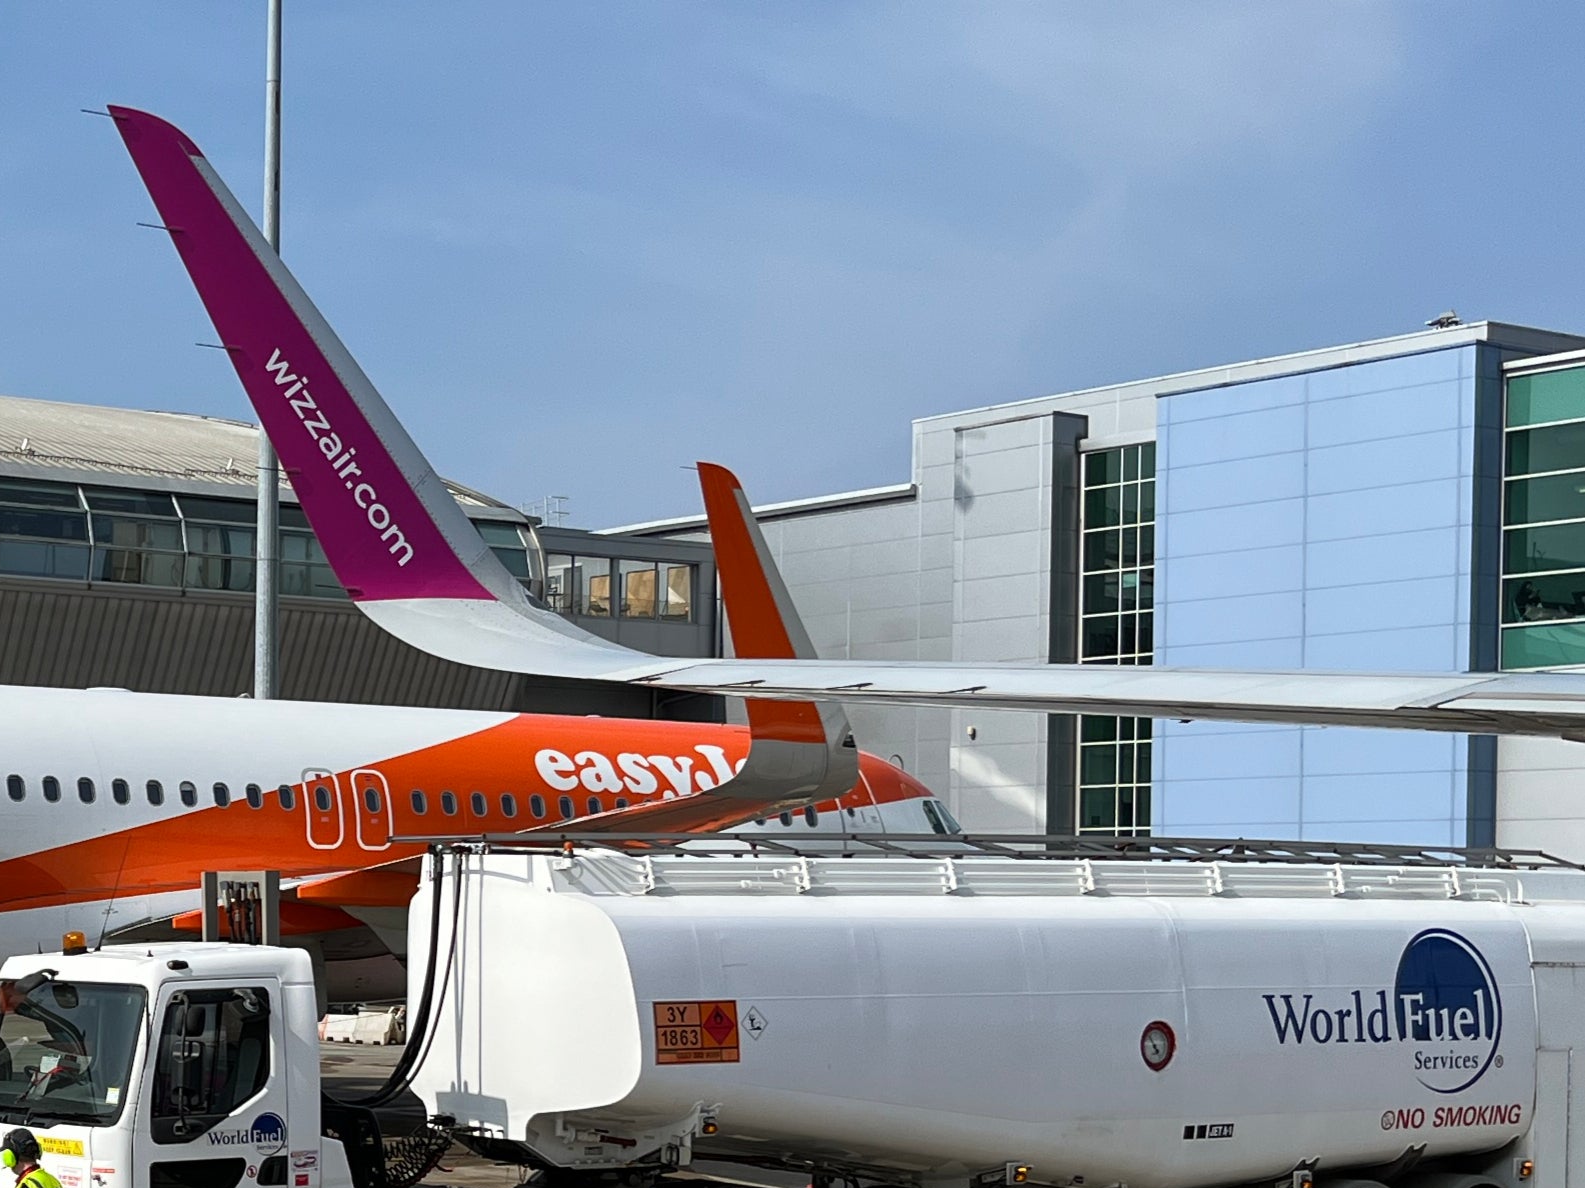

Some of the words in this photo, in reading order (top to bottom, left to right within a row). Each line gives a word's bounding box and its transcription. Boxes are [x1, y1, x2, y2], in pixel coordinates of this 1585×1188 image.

[265, 347, 414, 567] wizzair.com
[666, 1006, 688, 1023] 3Y
[1262, 989, 1392, 1044] World
[1399, 988, 1493, 1042] Fuel
[661, 1029, 699, 1046] 1863
[1414, 1049, 1479, 1071] Services
[1395, 1107, 1425, 1130] NO
[1432, 1104, 1522, 1128] SMOKING
[207, 1130, 250, 1146] World
[252, 1128, 282, 1142] Fuel
